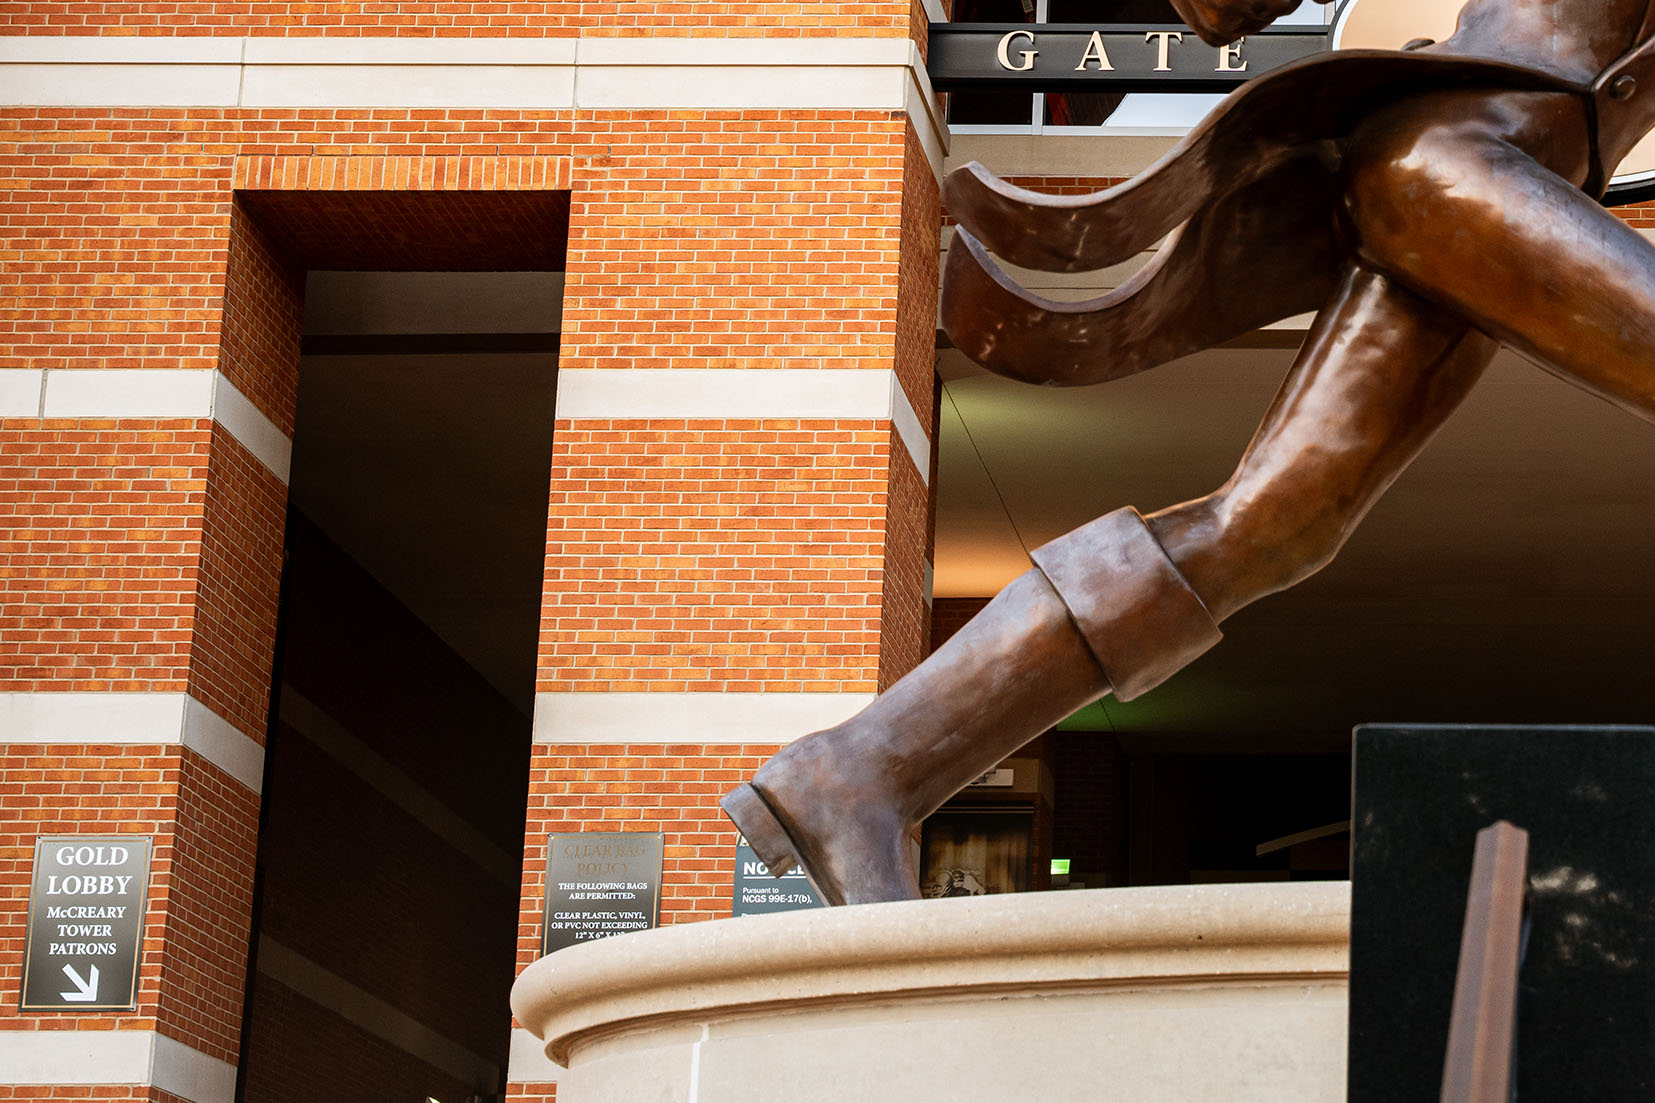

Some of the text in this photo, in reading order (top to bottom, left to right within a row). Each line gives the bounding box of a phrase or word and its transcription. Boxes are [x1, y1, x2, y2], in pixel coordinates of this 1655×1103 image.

[997, 30, 1248, 72] GATE
[56, 846, 129, 866] GOLD
[46, 875, 133, 895] LOBBY
[558, 882, 648, 890] THE FOLLOWING BAGS
[568, 892, 636, 900] ARE PERMITTED:
[742, 895, 767, 903] NCGS
[46, 906, 127, 919] McCREARY
[554, 911, 646, 920] CLEAR PLASTIC, VINYL,
[57, 924, 112, 937] TOWER
[551, 921, 648, 929] OR PVC NOT EXCEEDING
[49, 942, 117, 955] PATRONS
